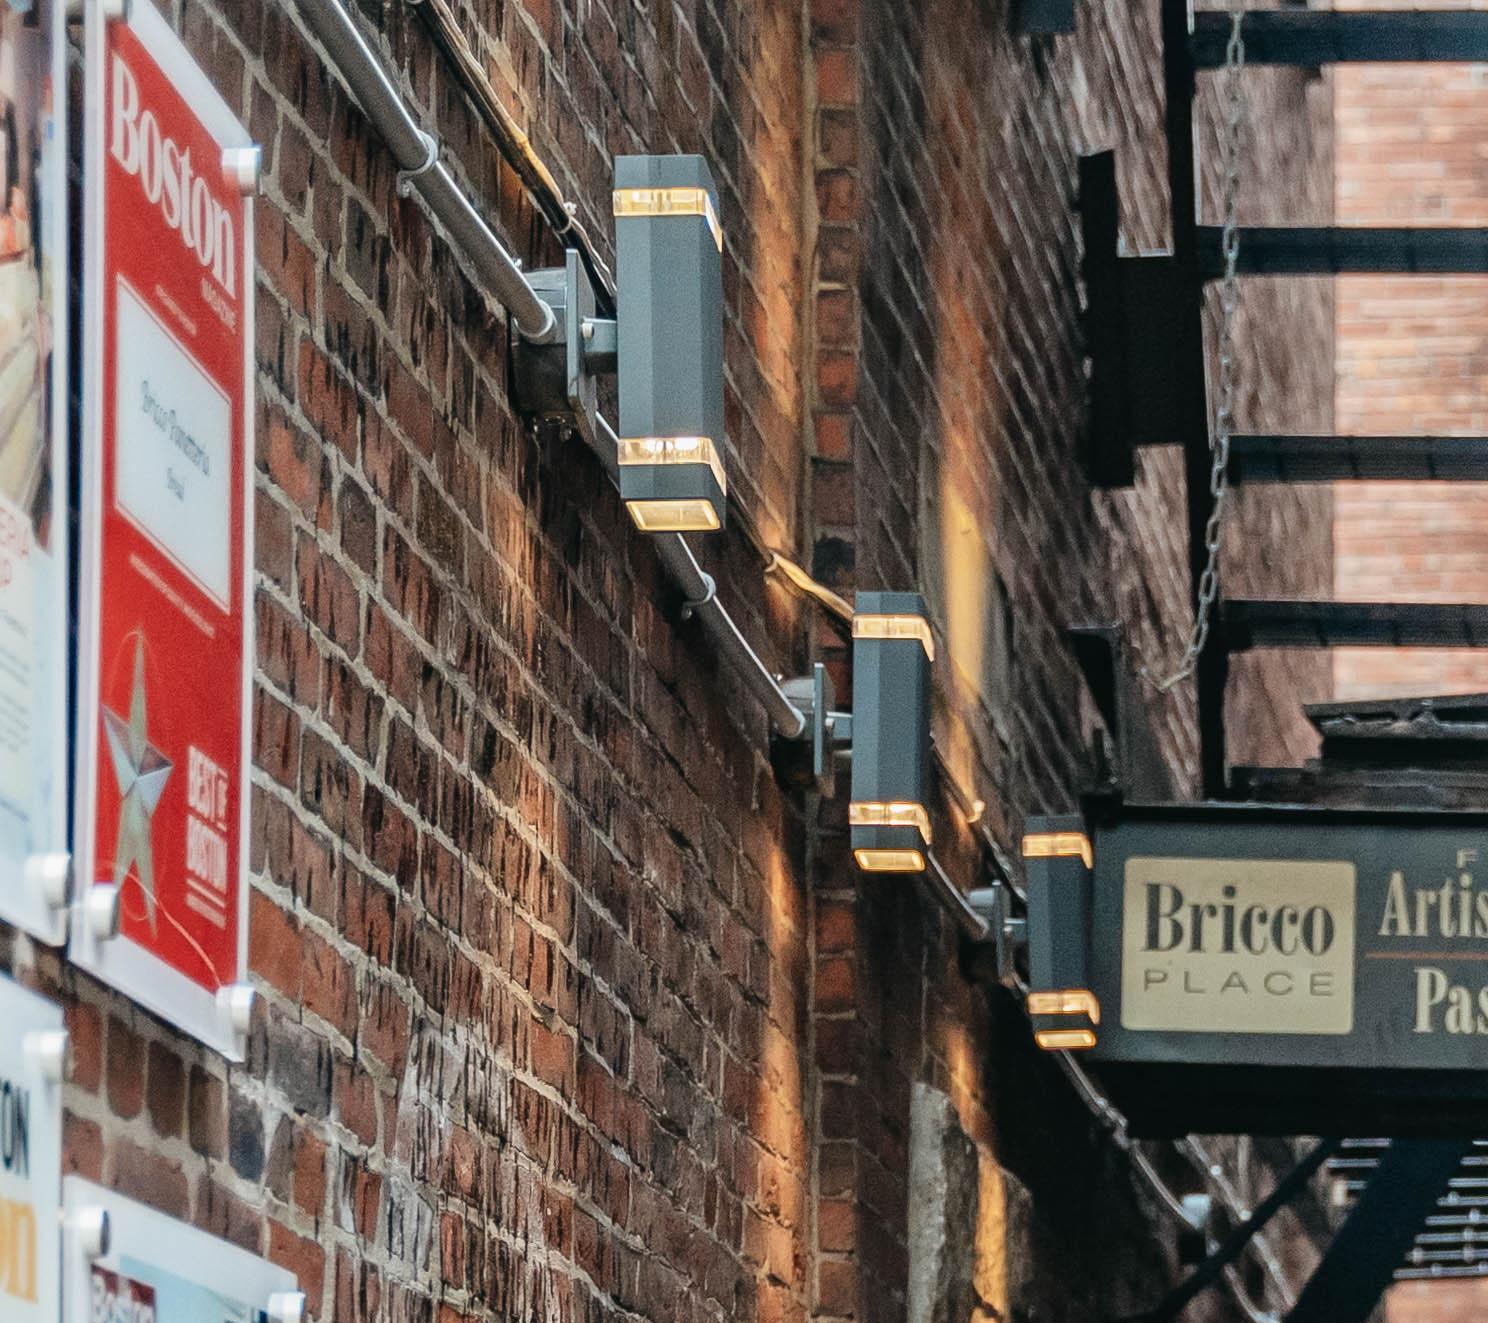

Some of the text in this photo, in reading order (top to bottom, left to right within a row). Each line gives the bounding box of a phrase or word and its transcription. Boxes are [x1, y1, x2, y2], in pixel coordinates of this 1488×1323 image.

[111, 51, 237, 300] Boston
[188, 744, 216, 824] BEST
[1140, 881, 1336, 957] Bricco
[1144, 968, 1335, 998] PLACE
